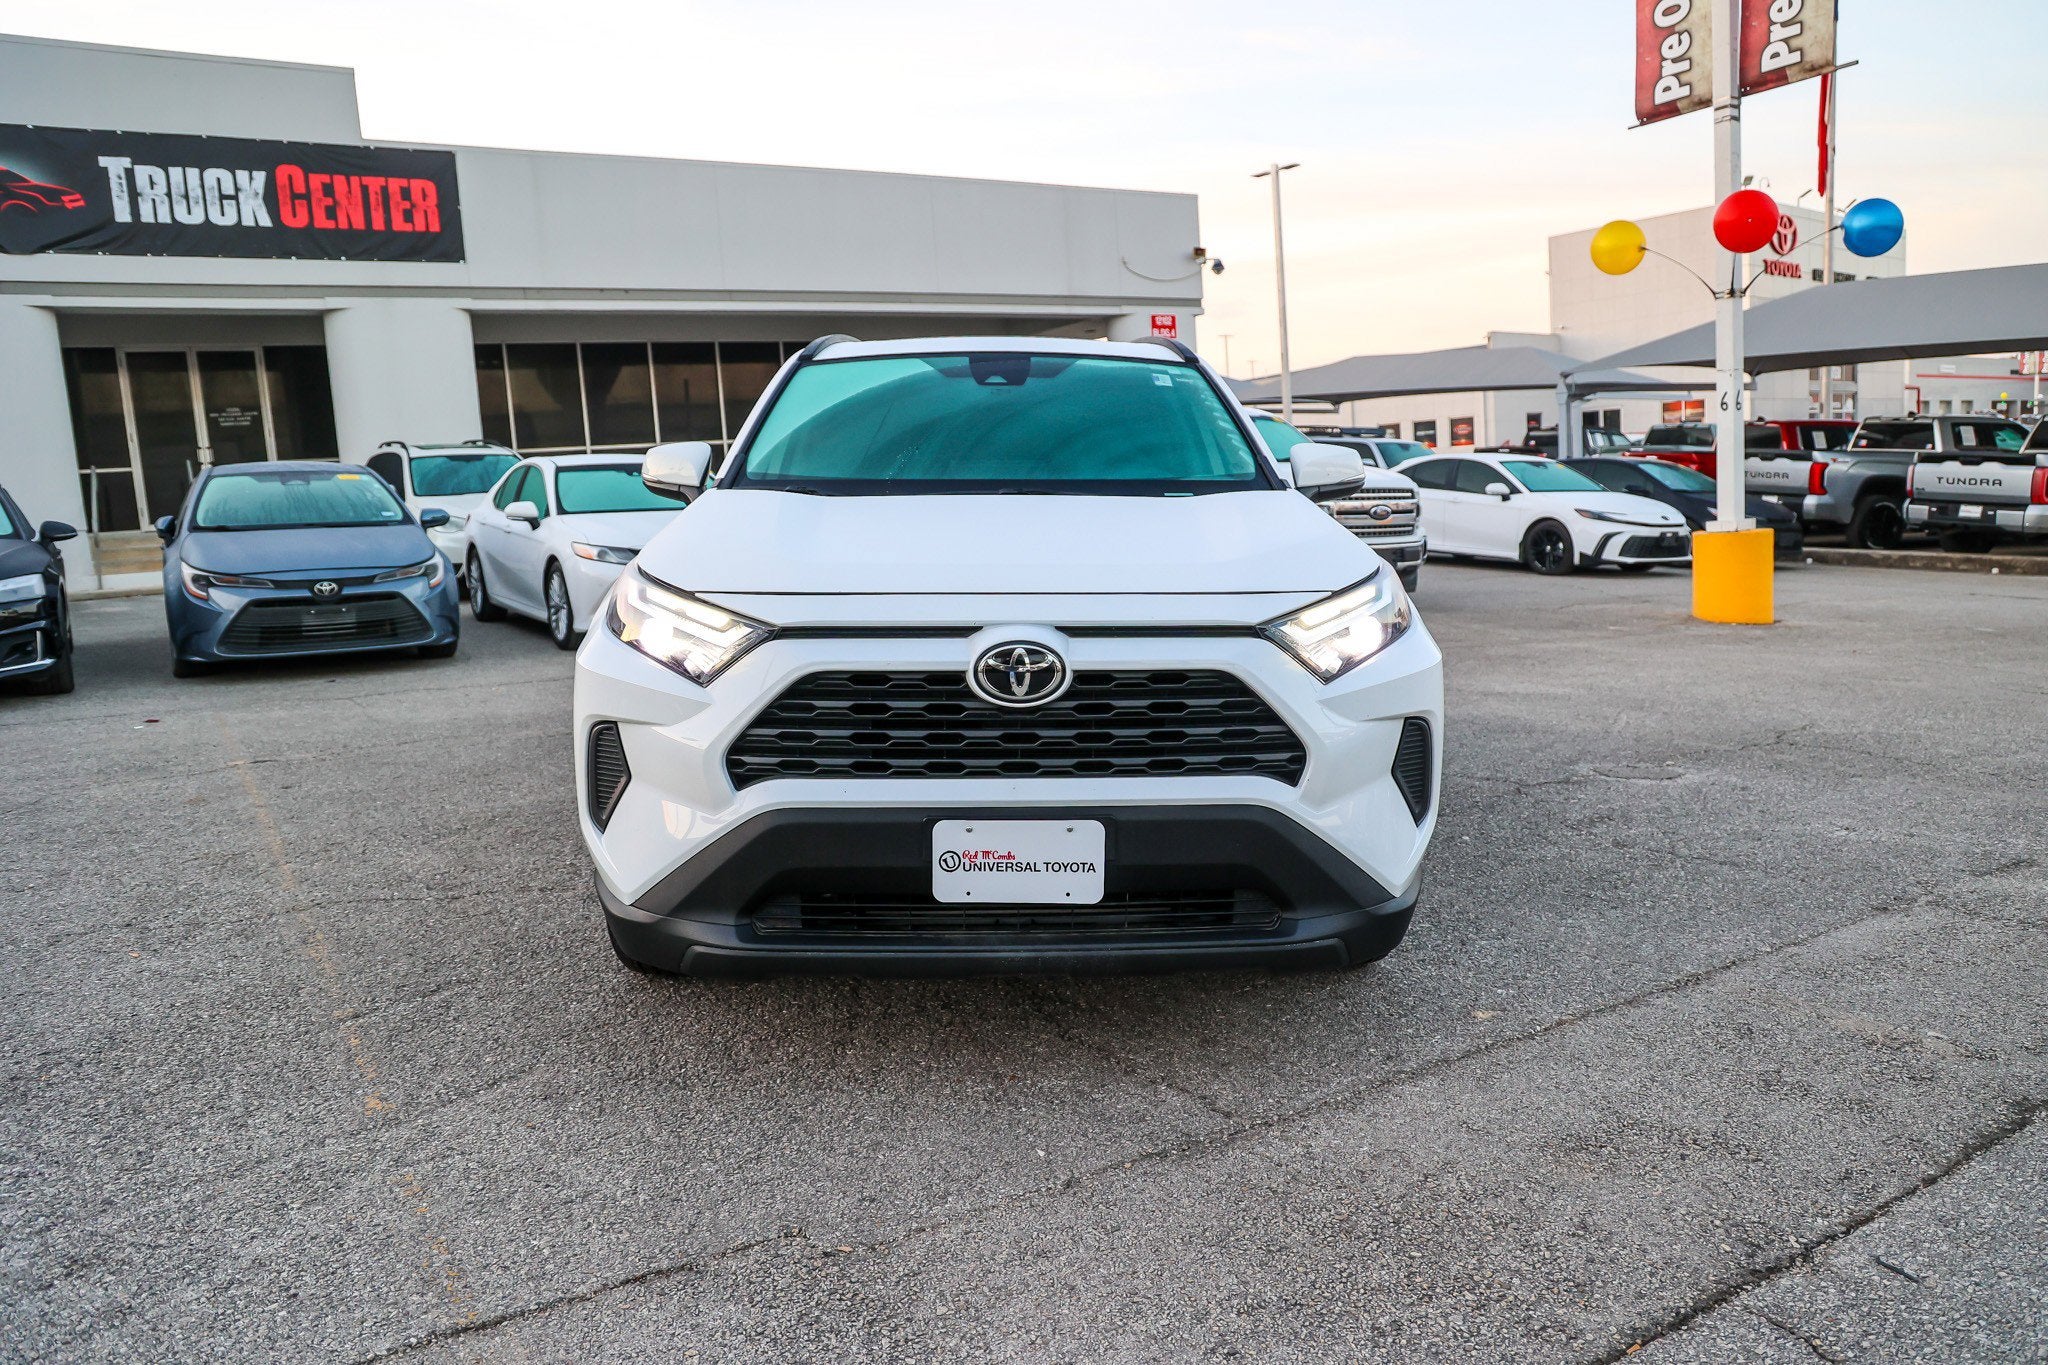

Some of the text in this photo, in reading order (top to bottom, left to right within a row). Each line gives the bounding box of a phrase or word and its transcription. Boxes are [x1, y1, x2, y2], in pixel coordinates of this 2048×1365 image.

[1760, 0, 1803, 74] Pre
[1653, 30, 1692, 106] Pre
[97, 155, 442, 233] TRUCK CENTER
[1763, 258, 1802, 278] TOYOTA
[1720, 391, 1729, 411] 6
[1735, 389, 1742, 411] 6
[1936, 476, 2003, 487] TUNDRA
[962, 850, 979, 863] Red
[962, 861, 1097, 873] UNIVERSAL TOYOTA
